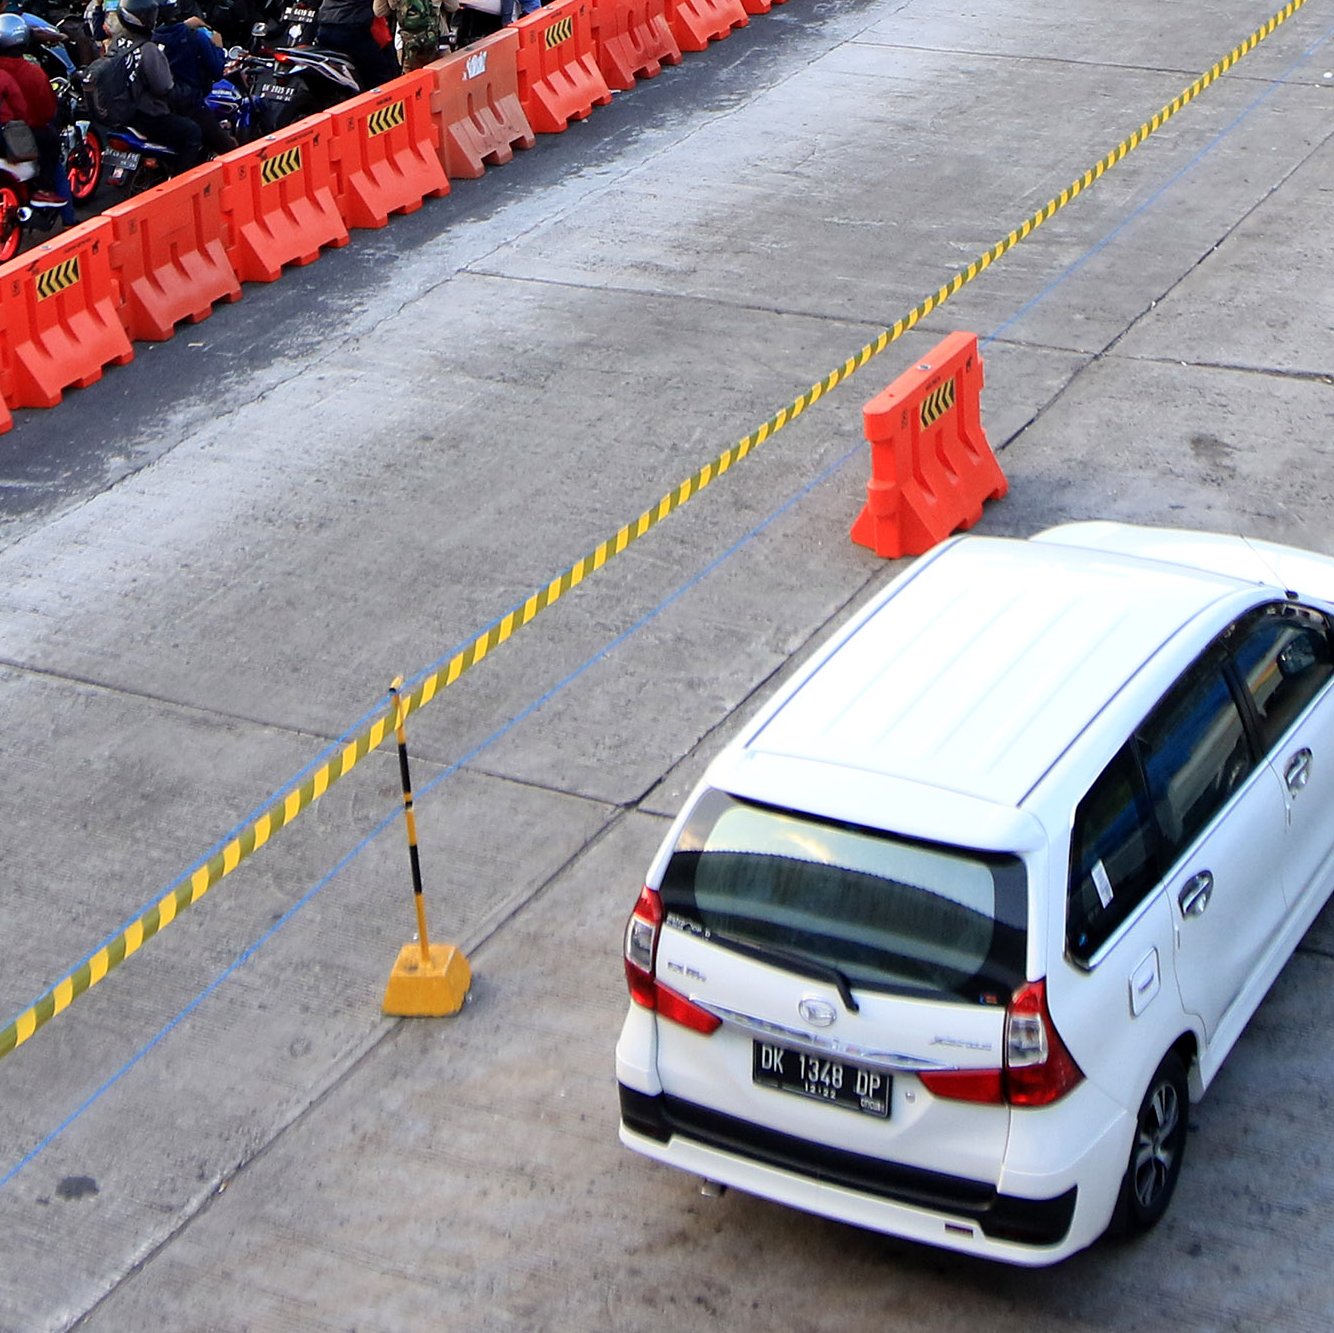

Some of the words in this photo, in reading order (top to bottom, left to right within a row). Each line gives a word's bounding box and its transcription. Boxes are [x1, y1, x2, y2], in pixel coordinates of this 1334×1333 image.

[762, 1047, 785, 1073] DK
[799, 1055, 844, 1089] 1348
[855, 1071, 881, 1098] DP
